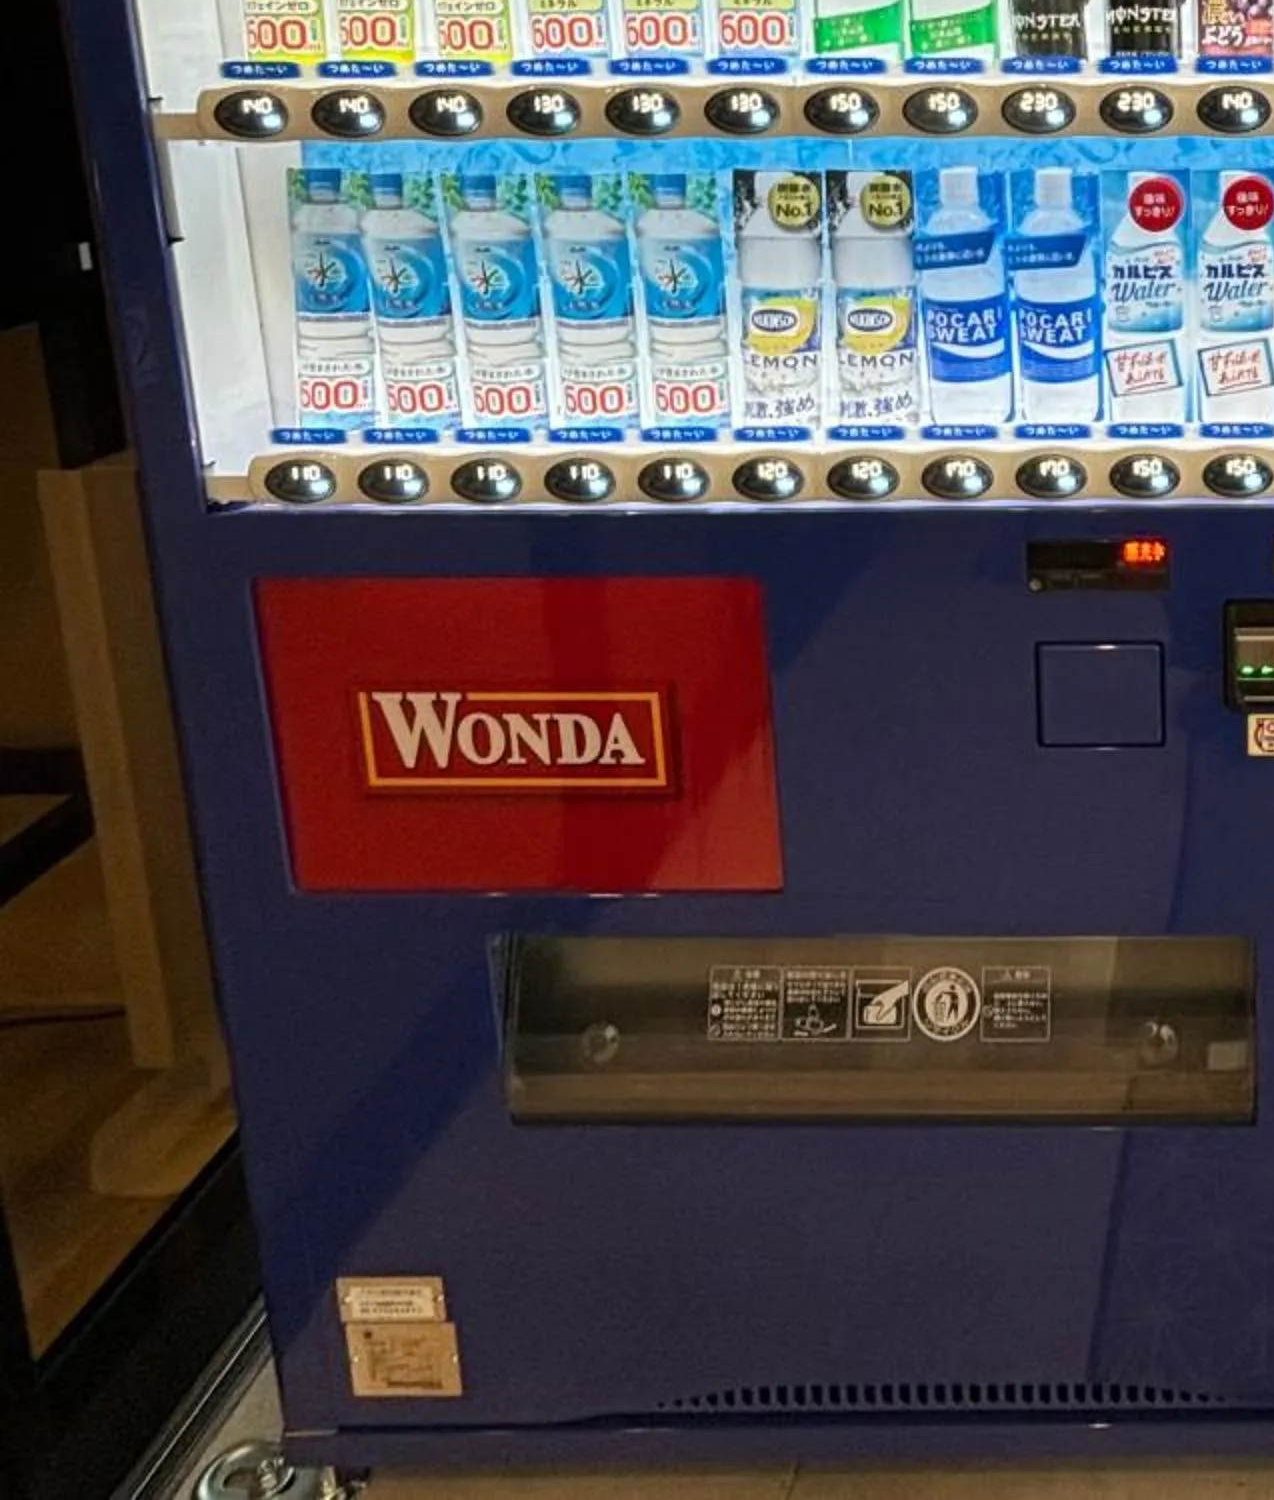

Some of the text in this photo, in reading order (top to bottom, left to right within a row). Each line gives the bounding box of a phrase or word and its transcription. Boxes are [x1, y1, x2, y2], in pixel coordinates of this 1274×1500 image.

[532, 15, 593, 50] 600
[626, 13, 688, 47] 600
[721, 13, 785, 47] 600
[1201, 25, 1244, 46] ぶどう
[241, 98, 272, 115] 140
[340, 97, 369, 115] 140
[436, 96, 466, 113] 140
[534, 95, 564, 113] 130
[632, 93, 663, 112] 130
[731, 93, 762, 112] 130
[829, 93, 862, 112] 150
[928, 93, 960, 112] 150
[1021, 92, 1058, 112] 230
[1117, 92, 1155, 112] 230
[1221, 92, 1254, 110] 140
[776, 203, 814, 218] No.1
[868, 202, 904, 217] No.1
[1112, 264, 1173, 279] カルピス
[1206, 263, 1265, 279] カルピス
[1112, 281, 1176, 301] Water
[1205, 280, 1268, 301] Water
[927, 306, 1003, 327] POCARI
[1019, 306, 1092, 329] POCARI
[927, 325, 996, 343] SWEAT
[1019, 325, 1087, 344] SWEAT
[291, 464, 321, 483] 110
[384, 464, 414, 483] 110
[477, 464, 506, 482] 110
[569, 464, 599, 482] 110
[663, 463, 693, 481] 110
[757, 461, 788, 480] 120
[851, 461, 882, 480] 120
[945, 461, 976, 480] 170
[1039, 460, 1071, 478] 170
[1132, 460, 1163, 478] 150
[1226, 459, 1257, 476] 150
[372, 691, 645, 769] WONDA
